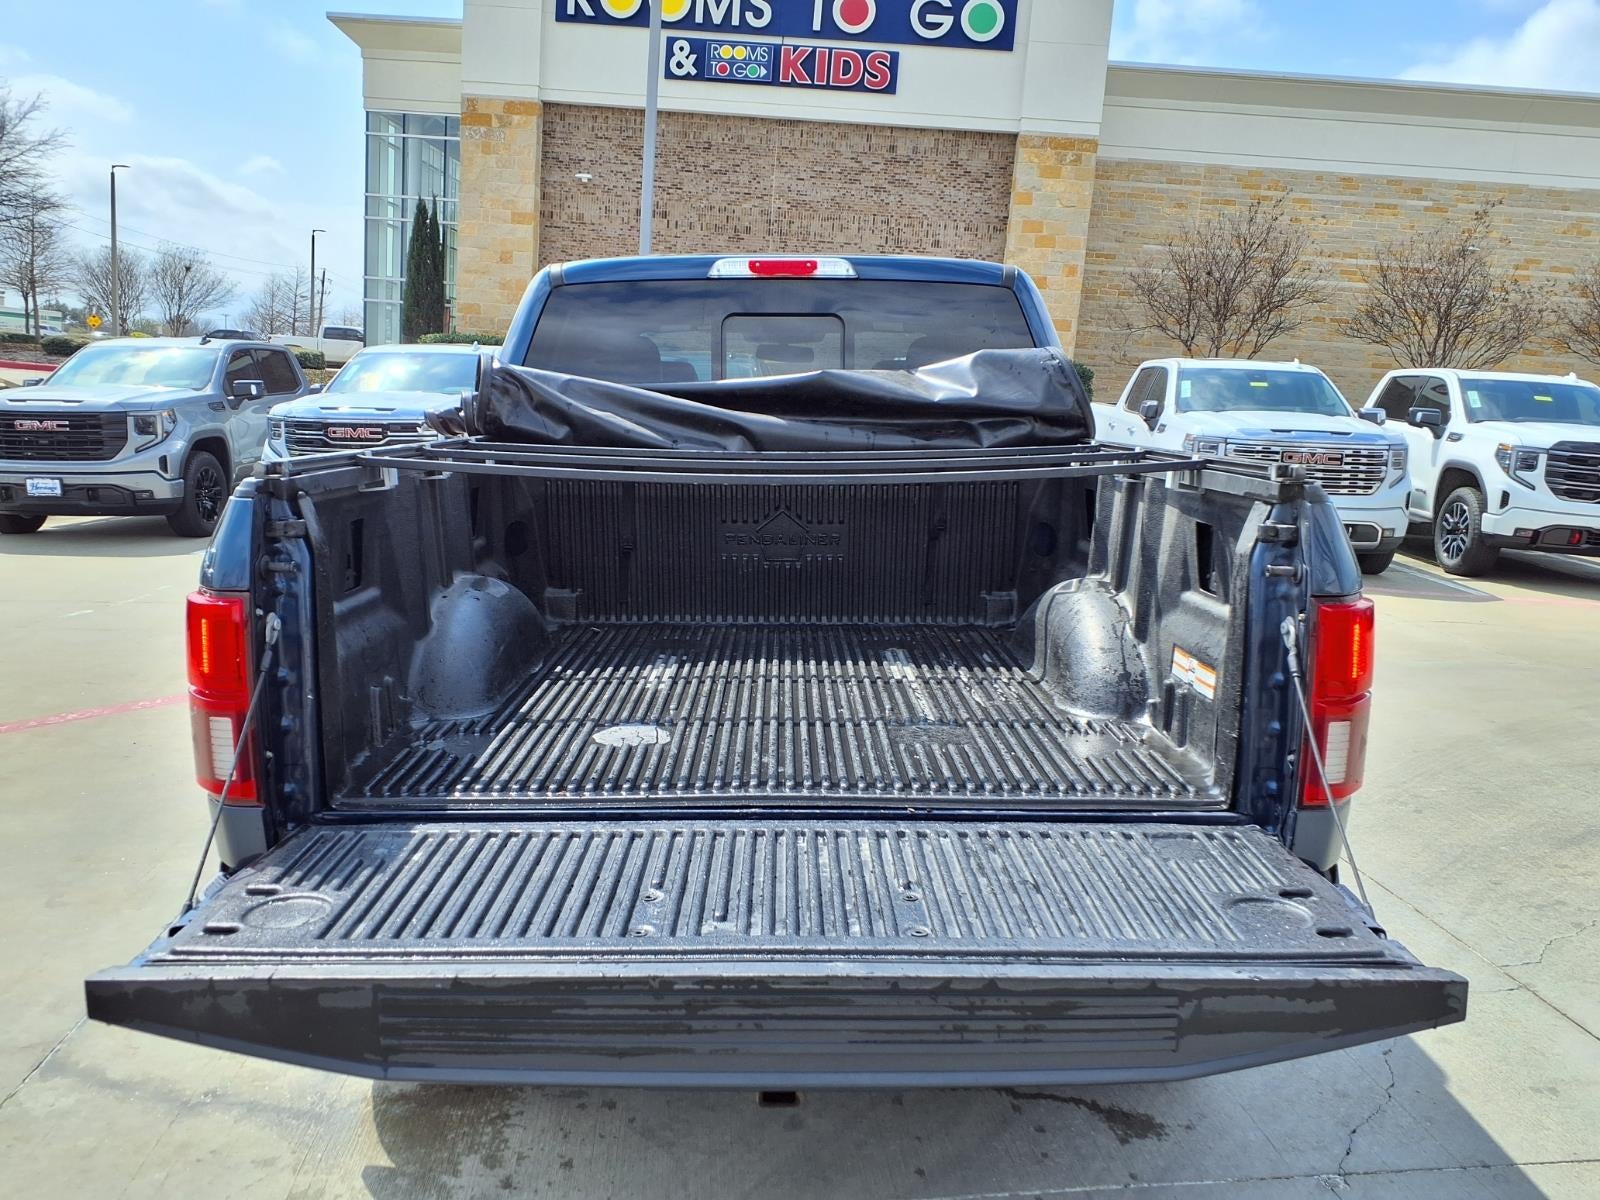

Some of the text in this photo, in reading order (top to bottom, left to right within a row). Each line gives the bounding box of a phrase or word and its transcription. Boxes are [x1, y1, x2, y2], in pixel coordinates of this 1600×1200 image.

[909, 0, 1005, 42] GO
[669, 39, 698, 77] &
[710, 43, 768, 61] ROOMS
[710, 61, 760, 78] TO GO
[779, 45, 891, 90] KIDS
[14, 419, 70, 431] GMC
[327, 426, 383, 439] GMC
[1283, 452, 1341, 465] GMC
